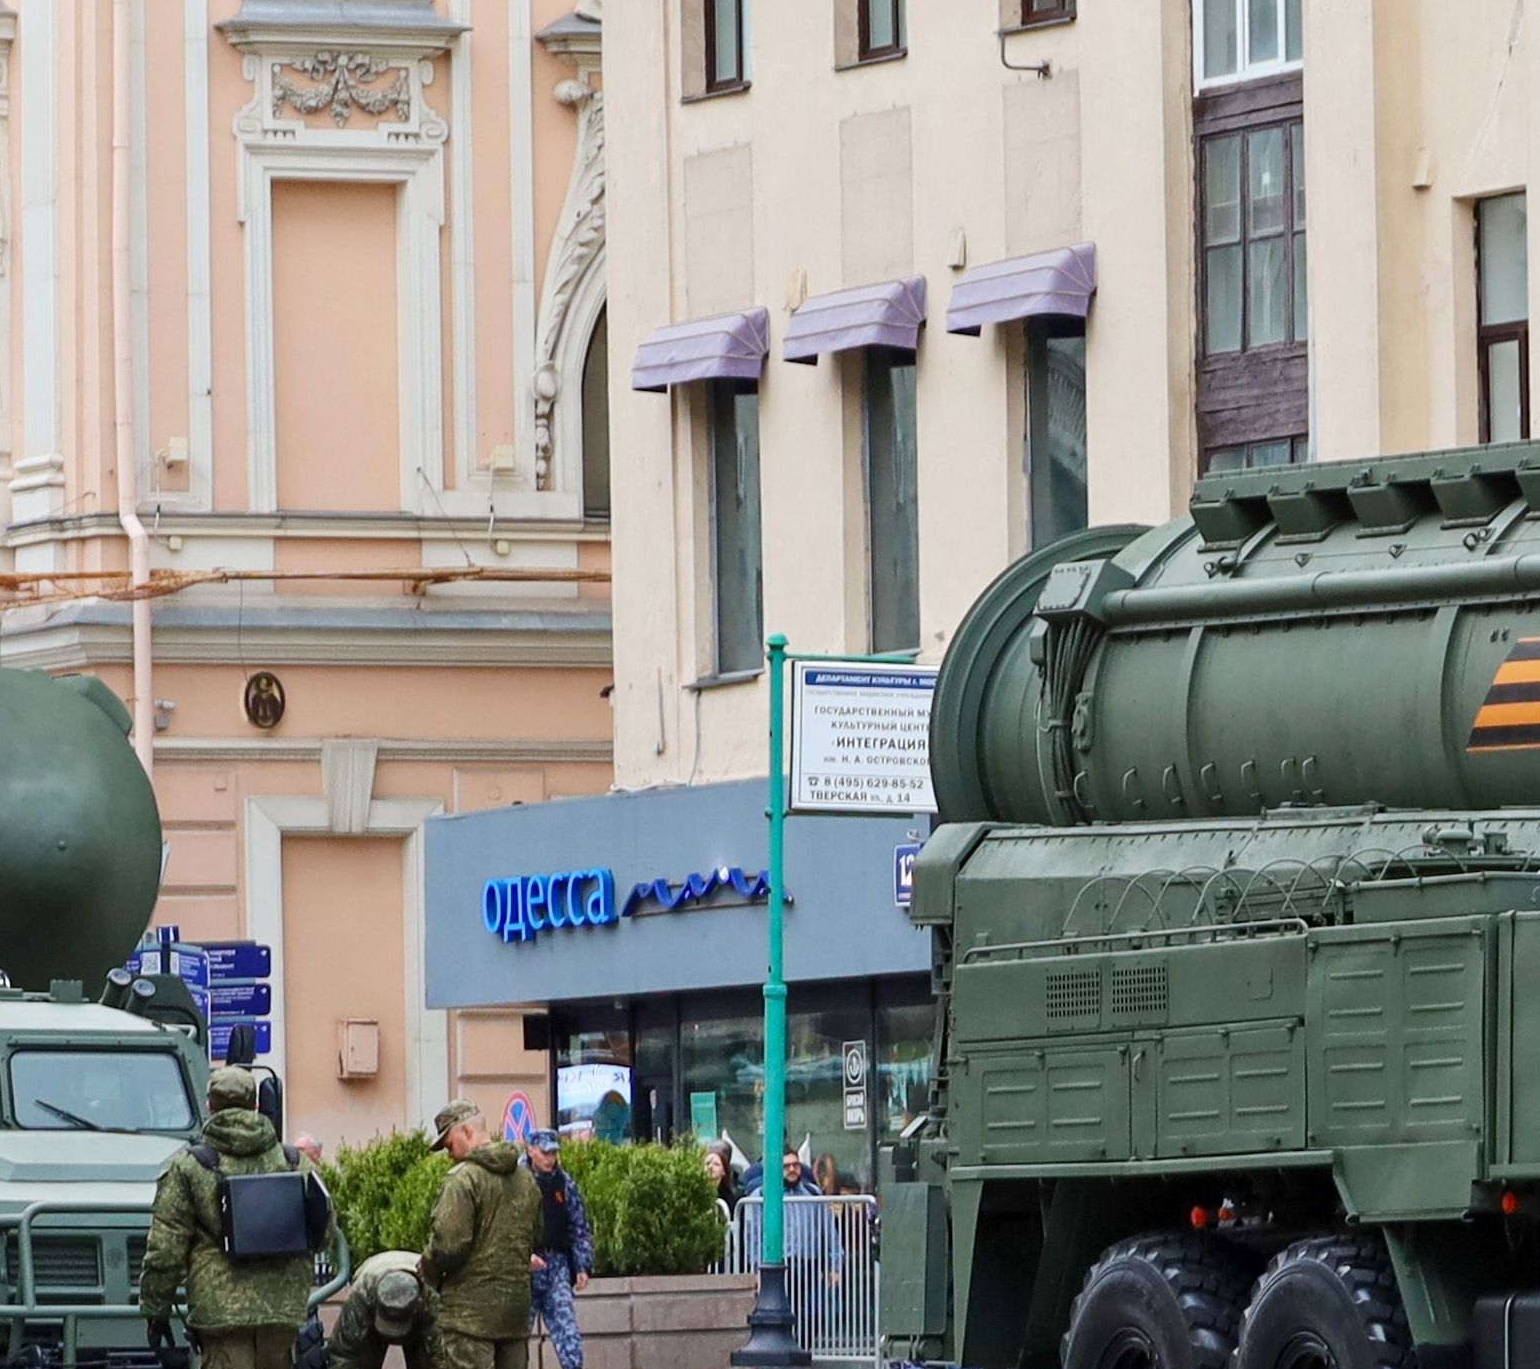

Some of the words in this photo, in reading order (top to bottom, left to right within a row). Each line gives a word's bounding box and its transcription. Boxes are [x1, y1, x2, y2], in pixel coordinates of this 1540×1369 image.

[815, 706, 914, 717] ГОСУДАРСТВЕННЫЙ
[831, 720, 897, 731] КУЛЬТУРНЫЙ
[824, 776, 831, 787] 8
[834, 776, 864, 789] (495)
[866, 777, 924, 790] 629-85-52
[810, 790, 867, 802] ТВЕРСКАЯ
[898, 792, 910, 803] 14
[483, 867, 610, 943] одесса
